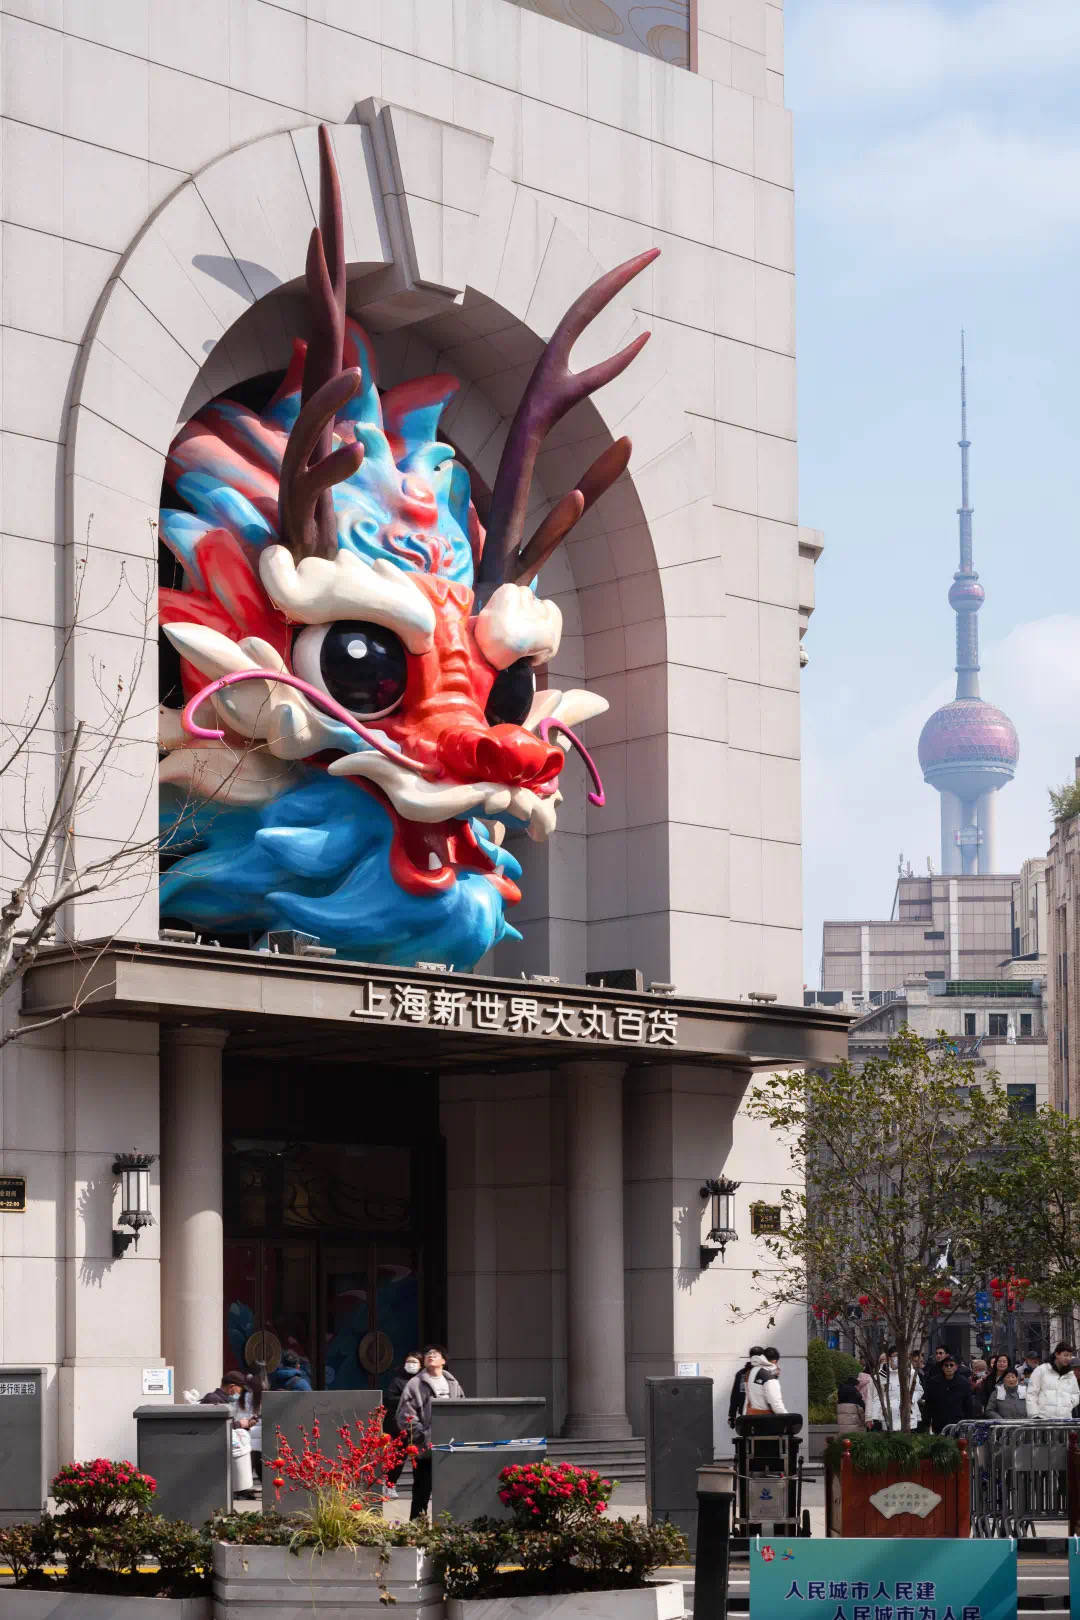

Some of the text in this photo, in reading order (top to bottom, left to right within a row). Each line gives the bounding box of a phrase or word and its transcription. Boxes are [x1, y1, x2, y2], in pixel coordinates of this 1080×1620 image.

[354, 981, 678, 1045] 上海新世界大丸百货
[784, 1581, 936, 1600] 人民城市人民建
